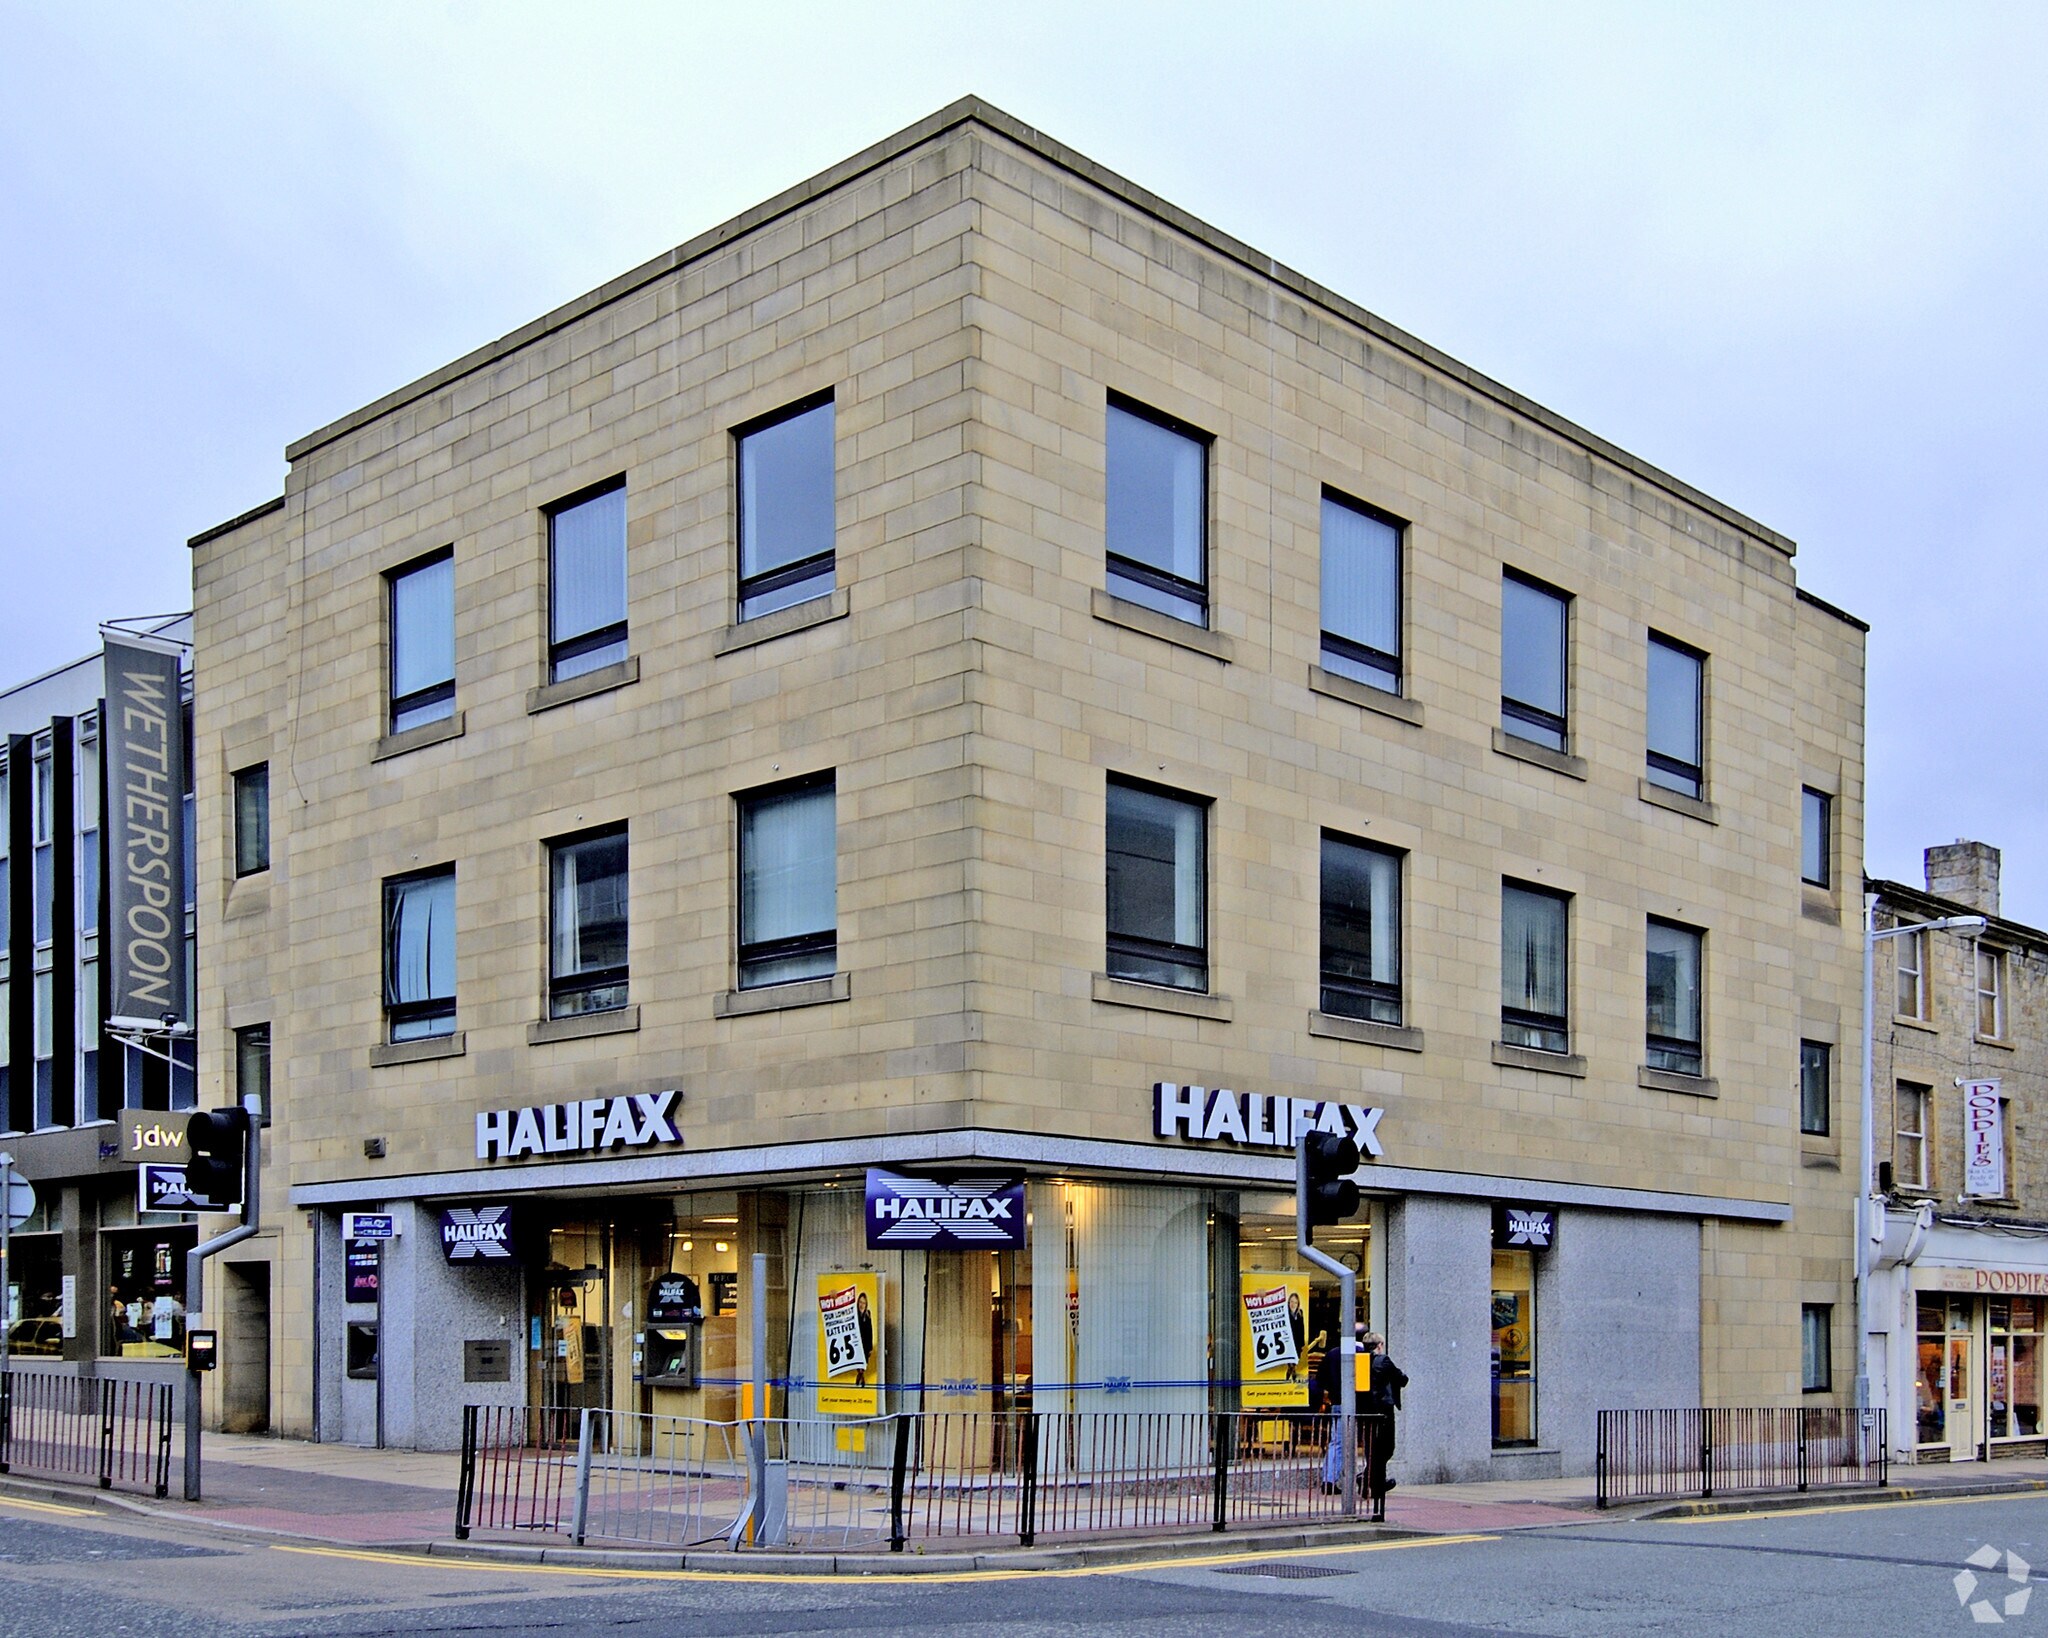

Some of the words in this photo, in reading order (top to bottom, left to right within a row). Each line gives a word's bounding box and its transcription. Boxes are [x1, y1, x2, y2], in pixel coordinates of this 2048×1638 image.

[122, 670, 171, 1007] WETHERSPOON
[475, 1090, 680, 1160] HALIFAX
[1155, 1081, 1385, 1156] HALIFAX
[1968, 1084, 1996, 1168] POPPIES
[132, 1124, 183, 1151] jdw
[875, 1198, 1013, 1219] HALIFAX
[444, 1223, 508, 1242] HALIFAX
[1508, 1219, 1551, 1235] HALIFAX
[659, 1288, 685, 1296] HALIFAX
[1245, 1296, 1263, 1308] HOT
[1250, 1310, 1262, 1318] OUR
[826, 1325, 841, 1337] RATE
[841, 1321, 855, 1333] EVER
[1252, 1323, 1270, 1334] RATE
[1271, 1320, 1287, 1331] EVER
[1103, 1381, 1131, 1389] HALIFAX
